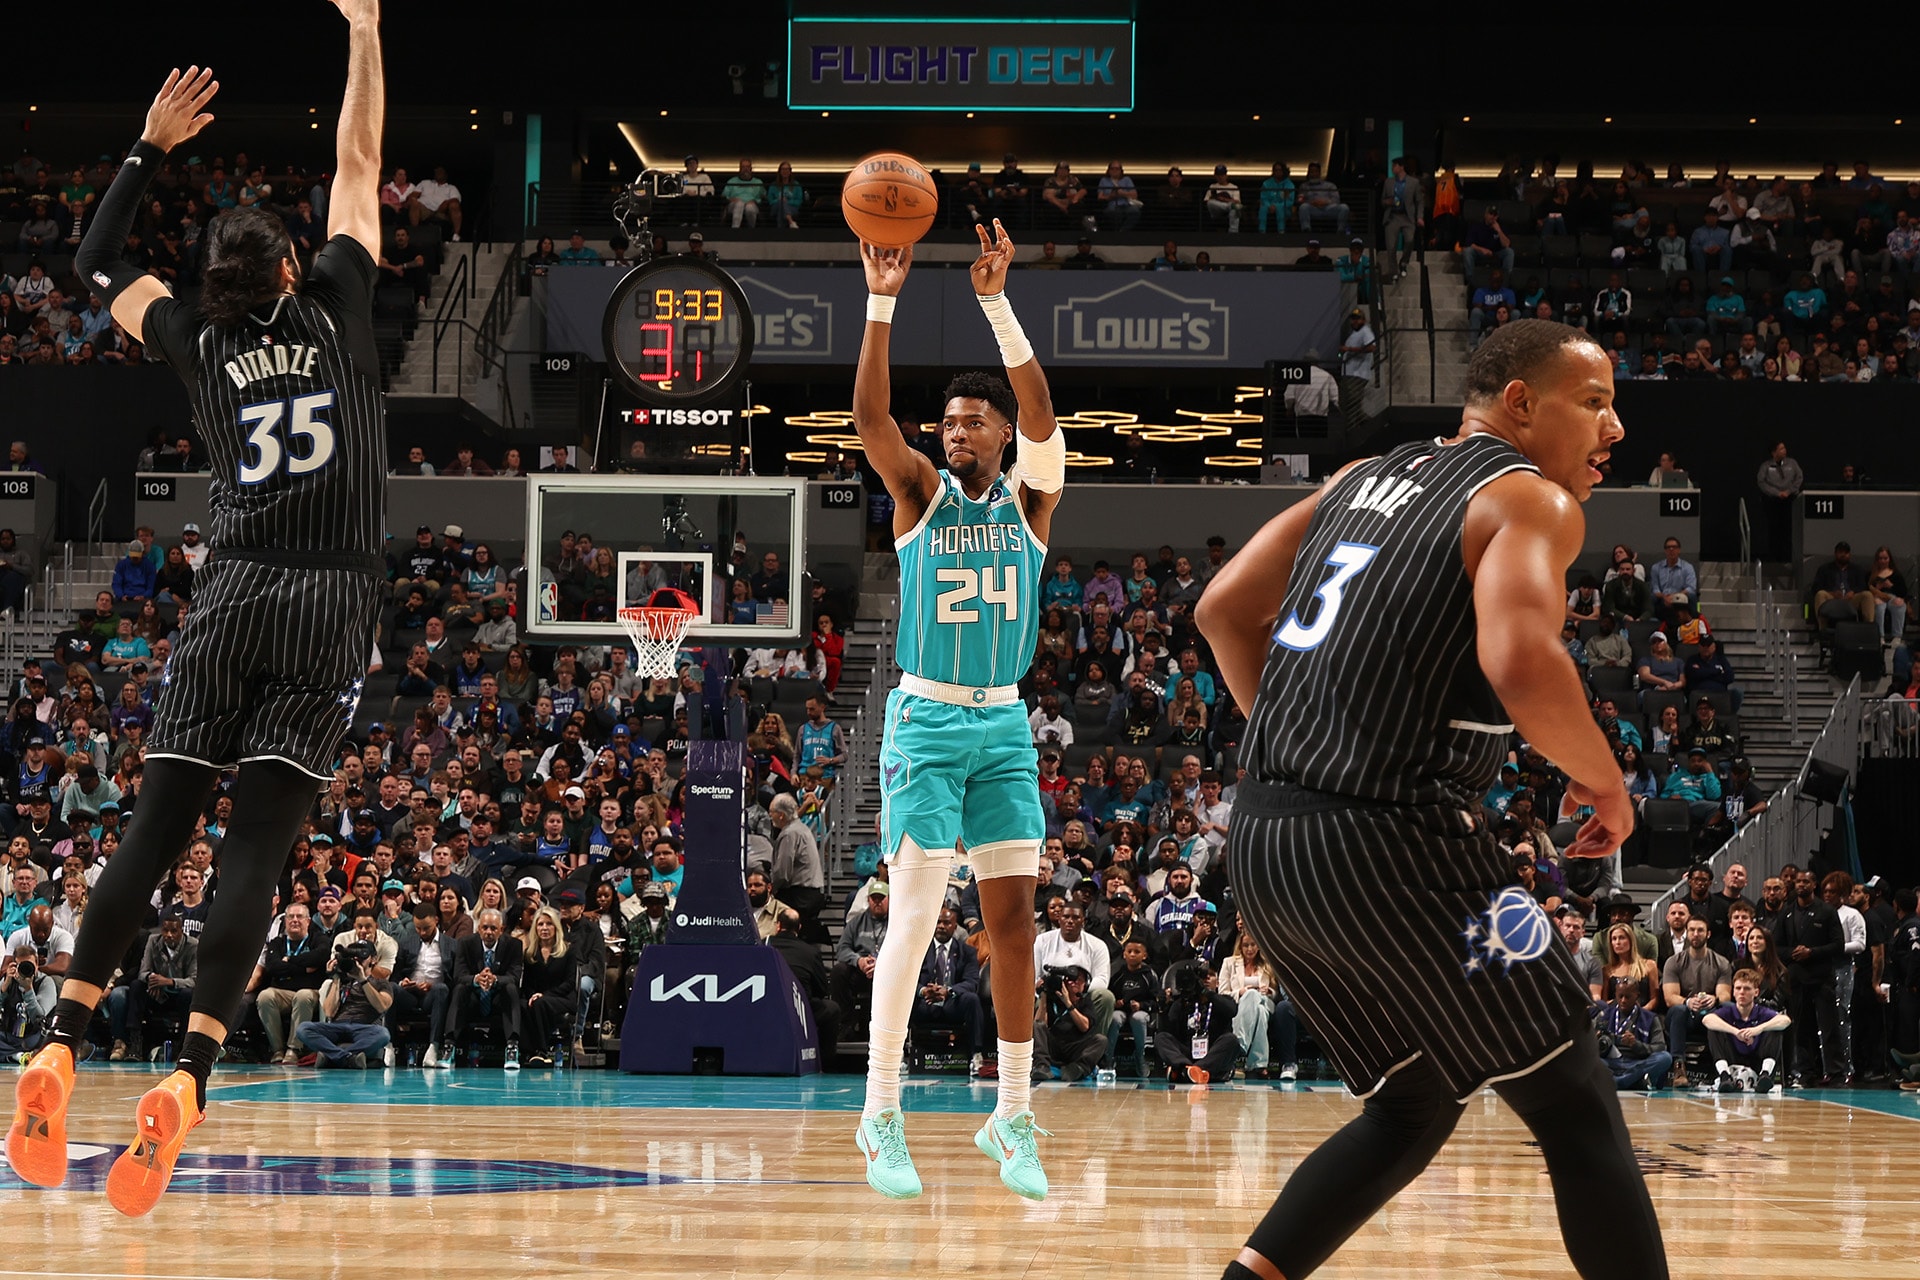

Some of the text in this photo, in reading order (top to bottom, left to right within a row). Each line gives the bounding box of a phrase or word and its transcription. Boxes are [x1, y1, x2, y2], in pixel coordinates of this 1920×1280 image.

[809, 46, 1115, 85] FLIGHT DECK
[864, 160, 925, 184] Wilson
[655, 289, 722, 321] 9:33
[1073, 311, 1210, 350] LOWE'S
[224, 344, 320, 390] BITADZE
[545, 359, 571, 371] 109
[1281, 367, 1303, 380] 110
[651, 409, 733, 425] TISSOT
[238, 389, 336, 485] 35
[2, 481, 29, 494] 108
[143, 483, 169, 495] 109
[827, 490, 854, 503] 109
[1348, 475, 1424, 519] BANE
[1668, 498, 1691, 511] 110
[1814, 500, 1833, 513] 111
[928, 523, 1023, 557] HORNETS
[936, 565, 1018, 624] 24
[1272, 540, 1381, 652] 3
[691, 785, 732, 796] Spectrum
[690, 916, 712, 926] Judi
[1160, 912, 1193, 925] CHARLOT
[650, 974, 766, 1003] KIA
